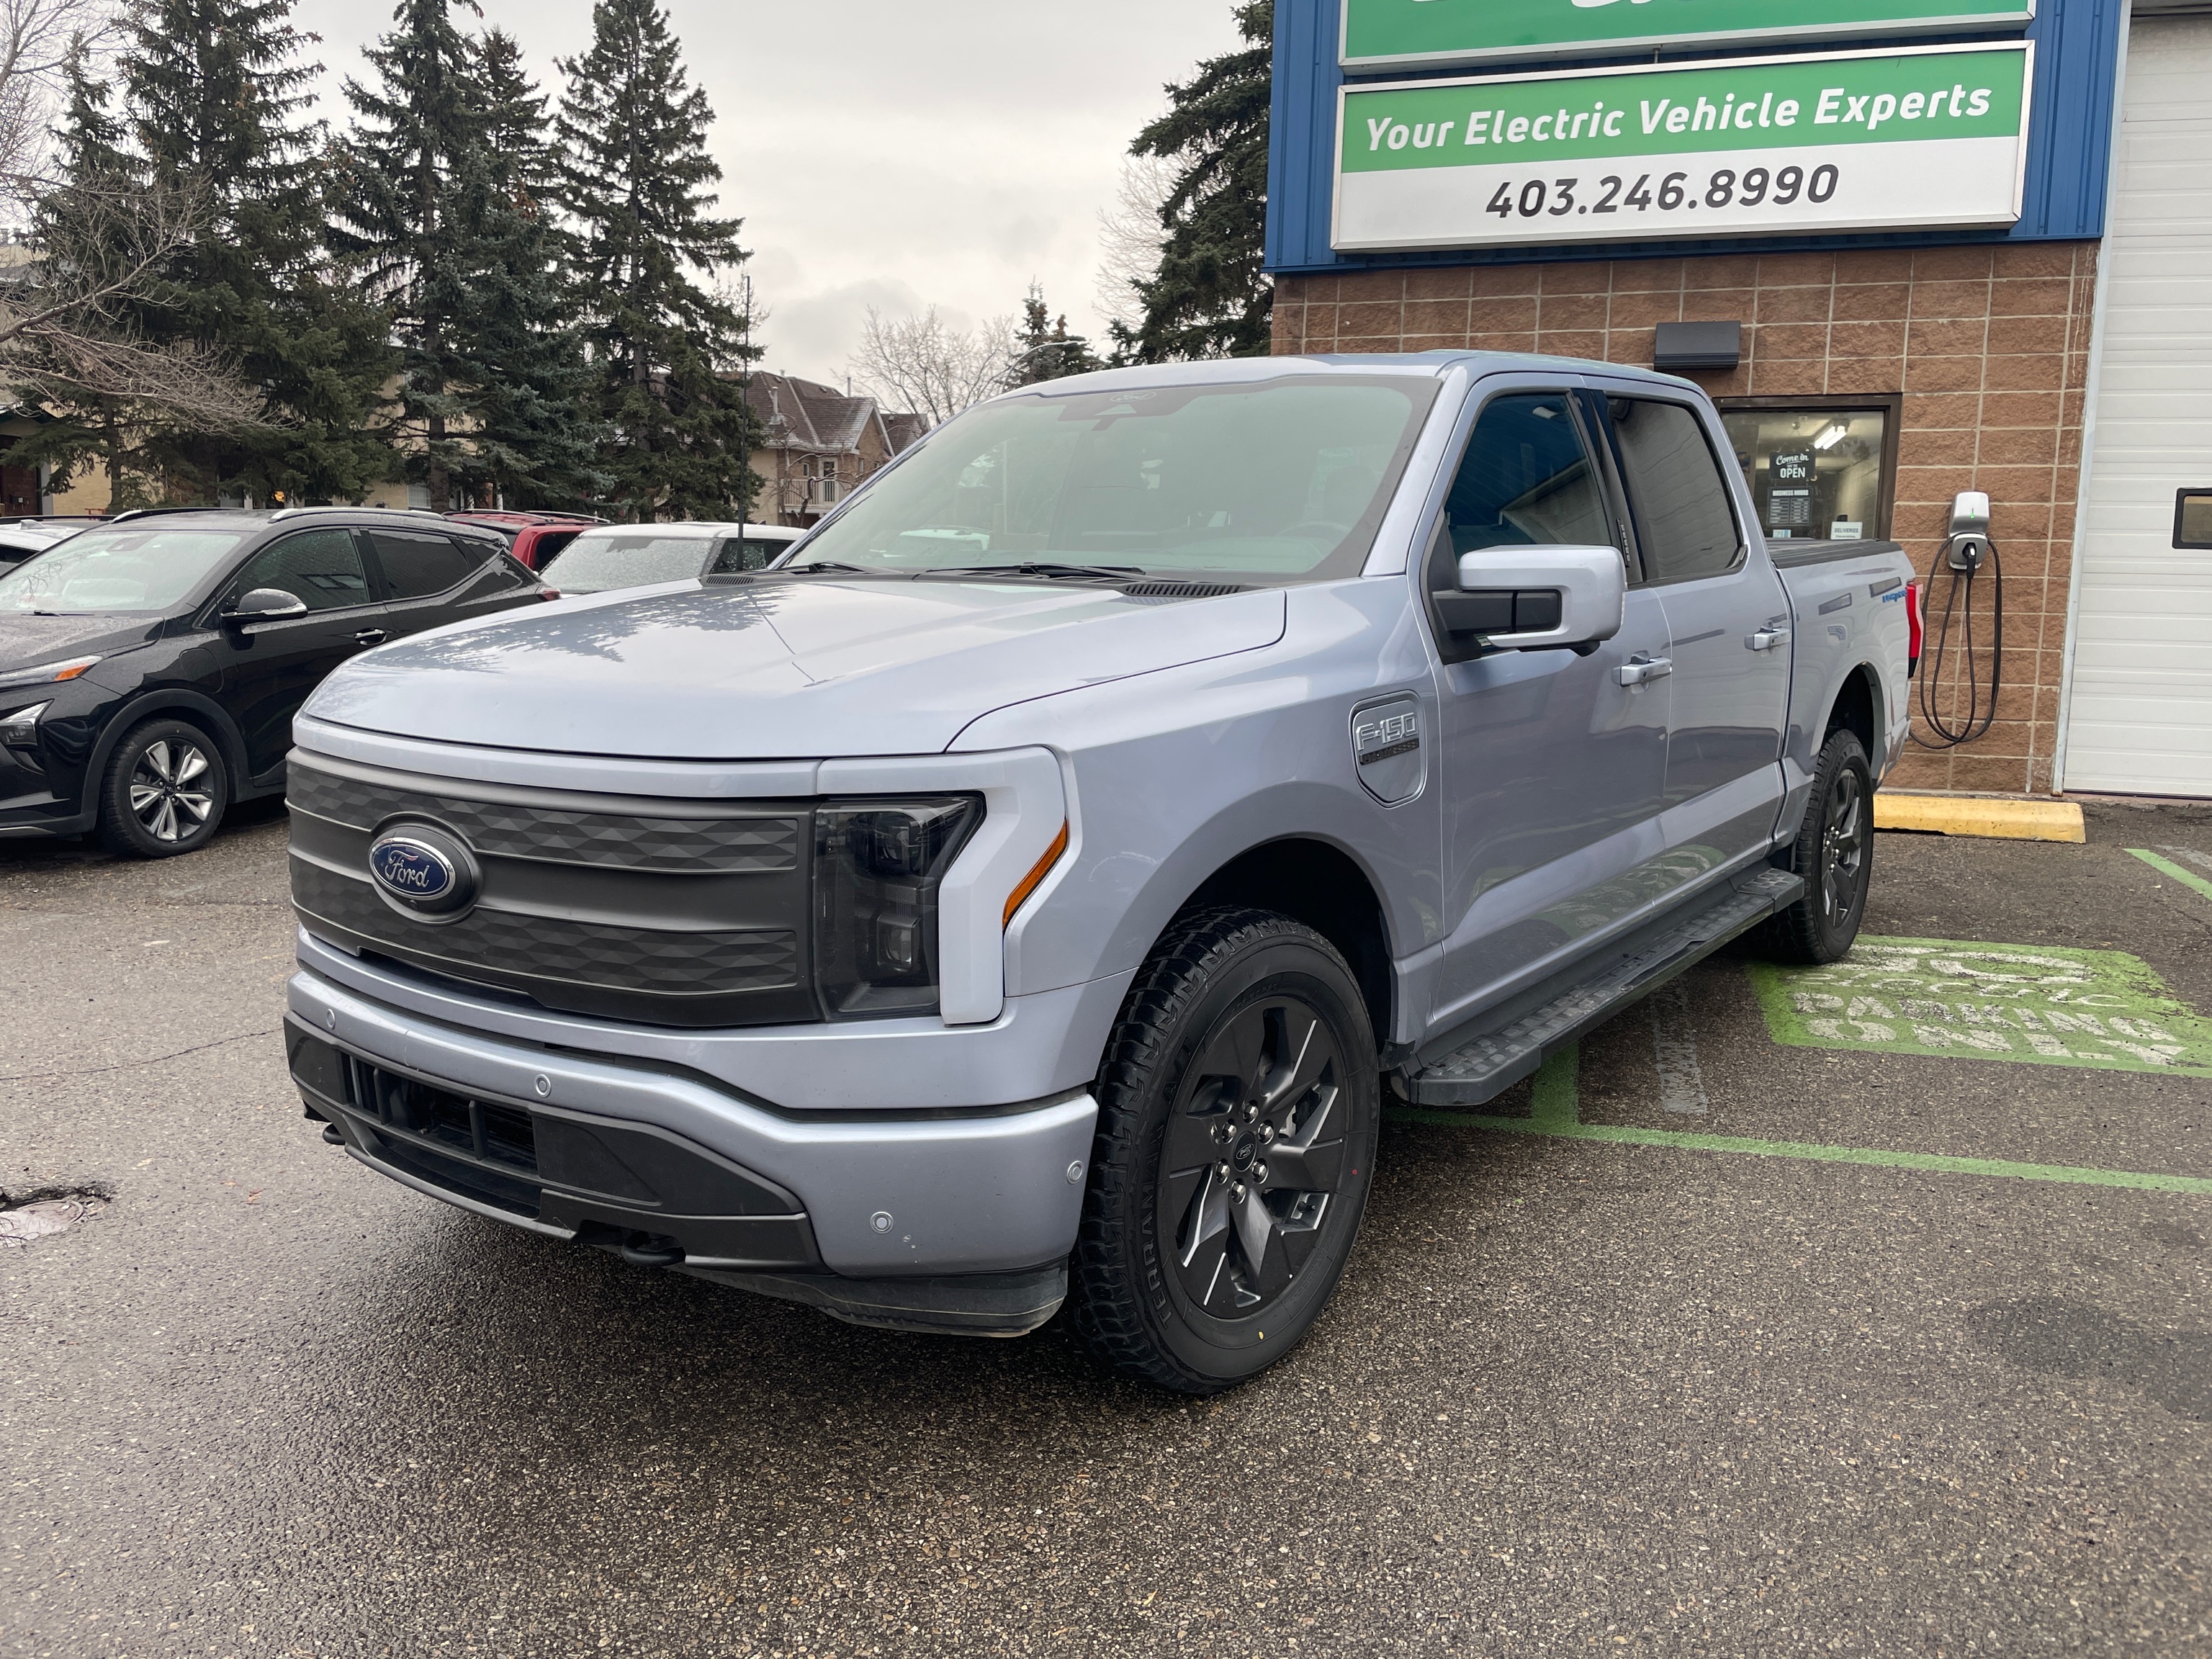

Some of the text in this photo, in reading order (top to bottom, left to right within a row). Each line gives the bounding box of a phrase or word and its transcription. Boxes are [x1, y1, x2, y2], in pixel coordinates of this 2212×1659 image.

[1366, 84, 1993, 151] Your Electric Vehicle Experts
[1485, 163, 1839, 218] 403.246.8990
[1776, 454, 1799, 465] Come
[1779, 467, 1806, 479] OPEN
[1355, 711, 1419, 751] F-150
[385, 850, 430, 888] Ford
[1794, 992, 2177, 1041] PARKING
[1807, 1017, 2188, 1066] ONLY
